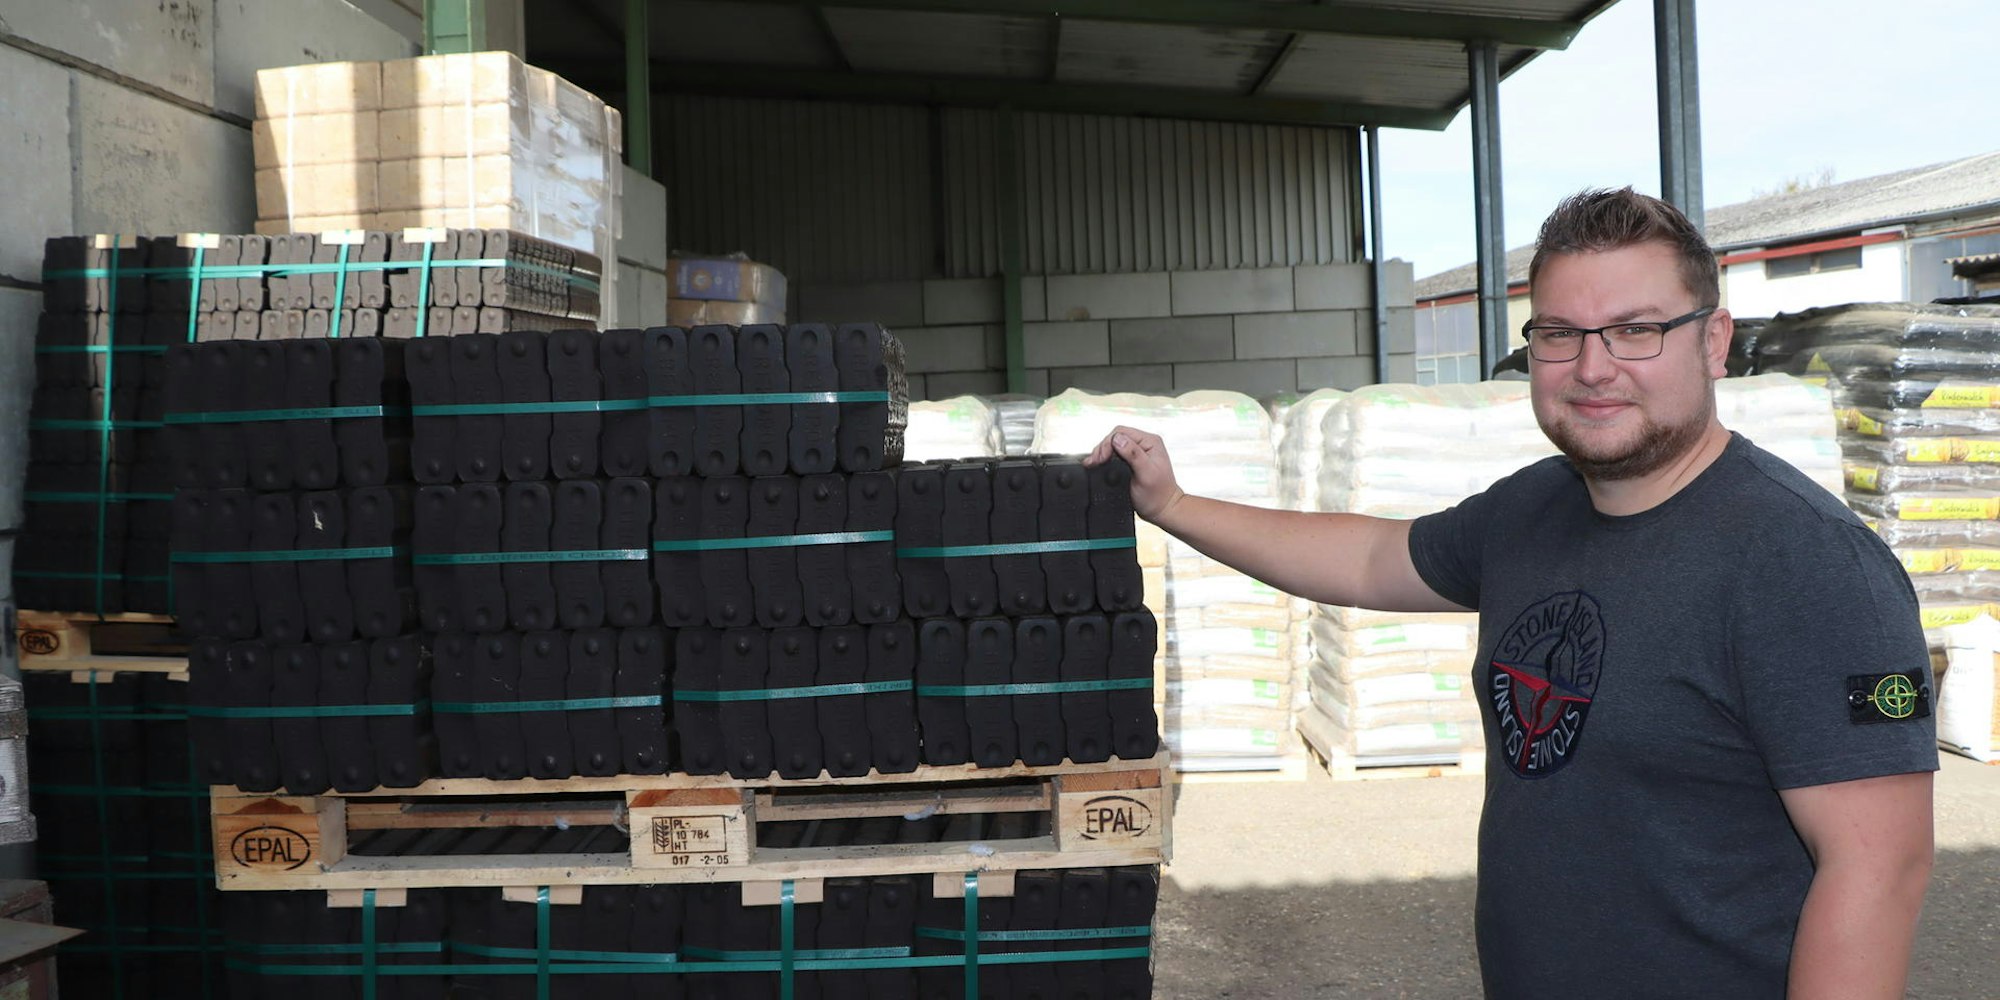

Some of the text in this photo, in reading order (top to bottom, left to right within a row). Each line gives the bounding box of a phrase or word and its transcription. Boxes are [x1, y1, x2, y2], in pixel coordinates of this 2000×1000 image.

[1504, 601, 1598, 687] STONE ISLAND
[1494, 673, 1580, 769] STONE ISLAND
[1086, 807, 1141, 833] EPAL
[674, 841, 688, 850] HT
[676, 830, 710, 840] 10 784
[244, 837, 300, 862] EPAL
[672, 855, 690, 865] 017
